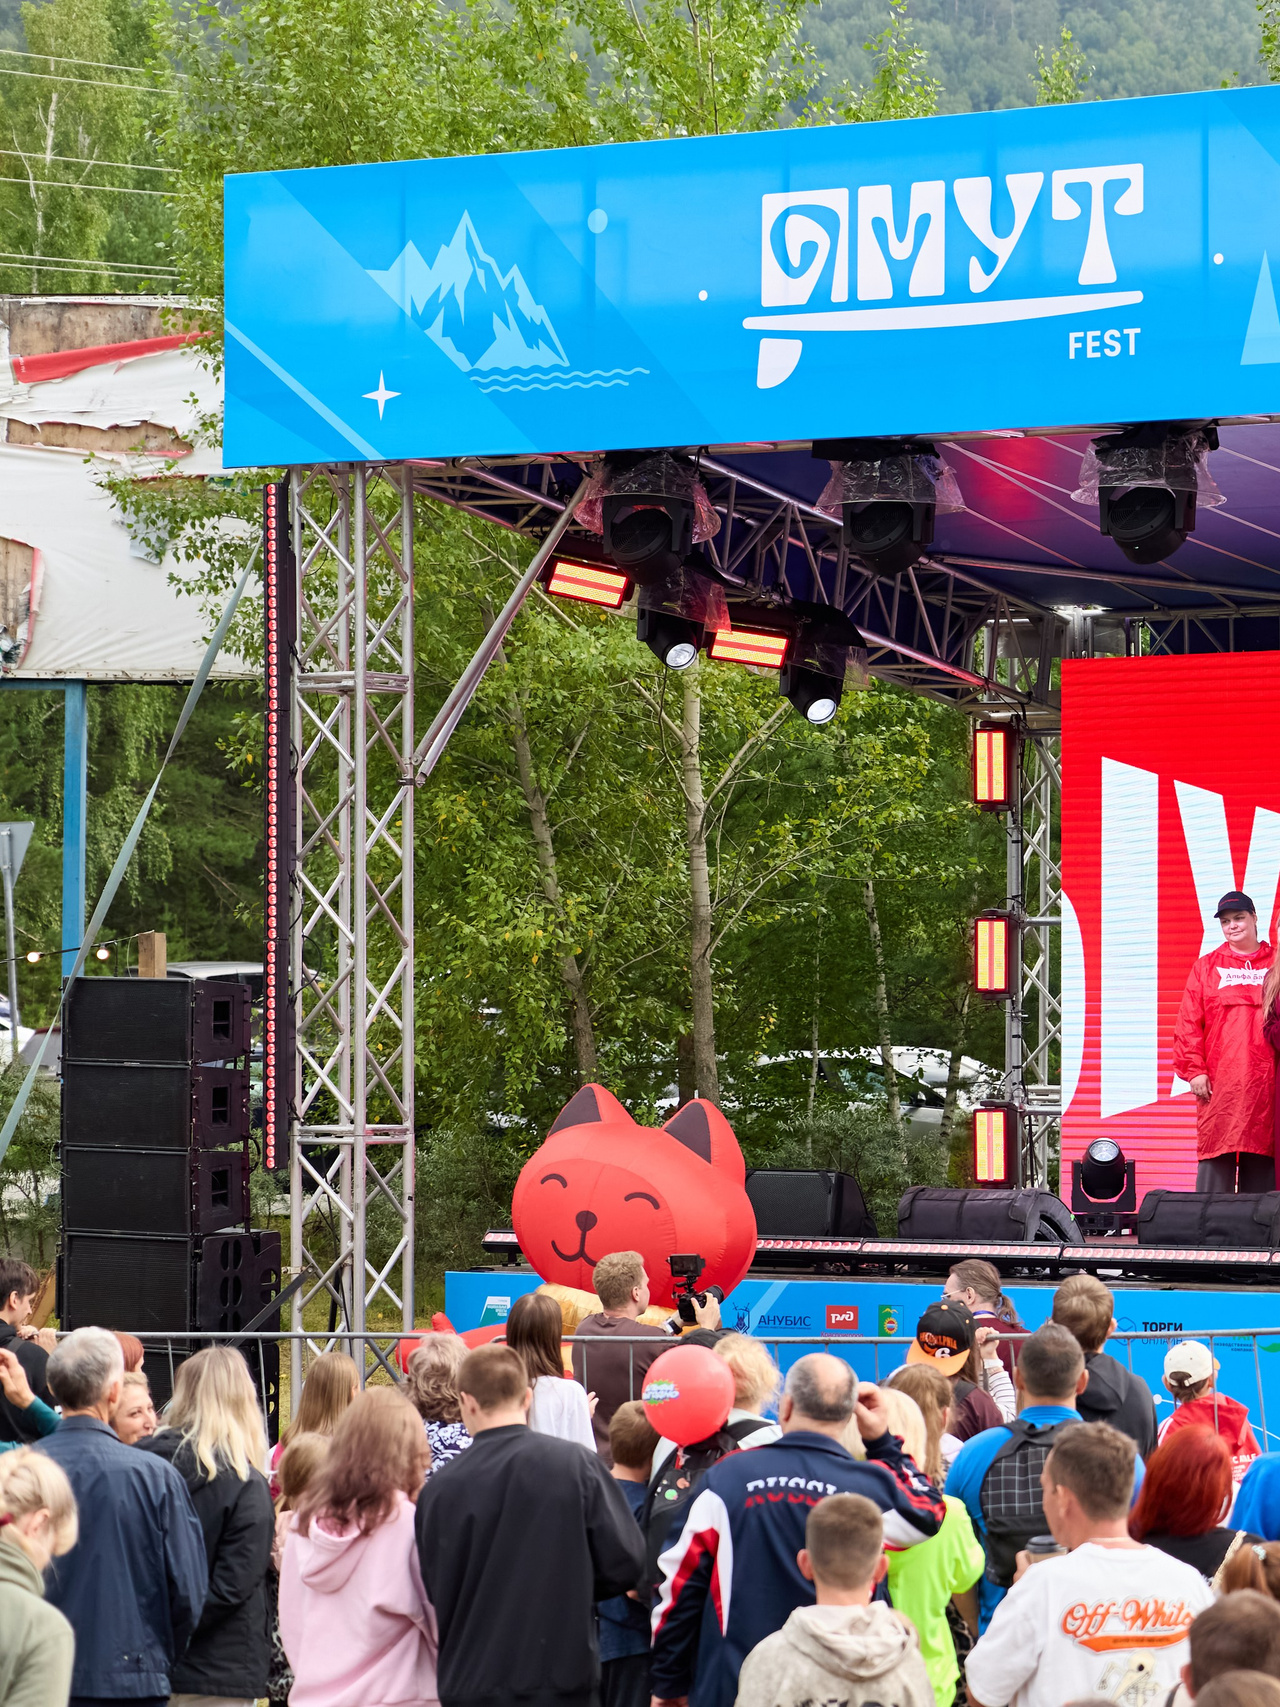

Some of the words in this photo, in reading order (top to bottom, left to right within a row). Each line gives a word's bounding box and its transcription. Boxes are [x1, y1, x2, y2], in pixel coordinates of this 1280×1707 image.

[1068, 327, 1142, 360] FEST
[1226, 973, 1251, 981] Альфа
[758, 1314, 811, 1327] АНУБИС
[1142, 1321, 1183, 1332] ТОРГИ
